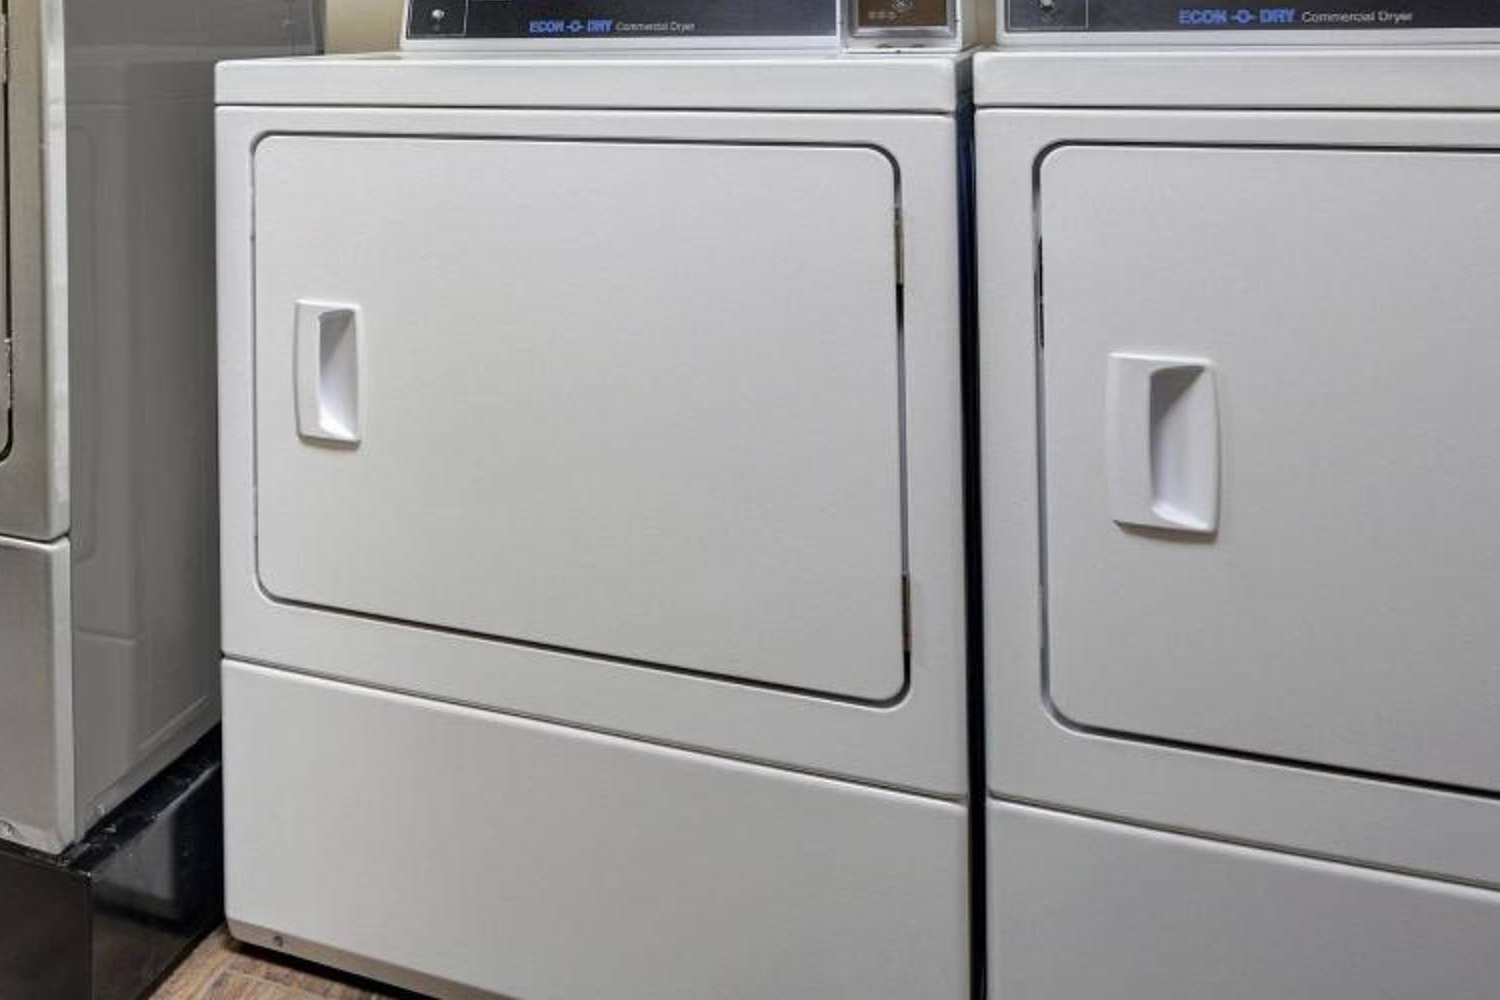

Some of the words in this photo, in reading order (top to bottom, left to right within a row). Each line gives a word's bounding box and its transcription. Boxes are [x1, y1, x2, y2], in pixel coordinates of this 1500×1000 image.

[1179, 9, 1227, 24] ECON
[1259, 8, 1296, 23] DRY
[1301, 10, 1375, 23] Commercial
[1378, 10, 1413, 24] Dryer
[529, 20, 565, 33] ECON
[616, 21, 668, 32] Commercial
[670, 21, 695, 33] Dryer
